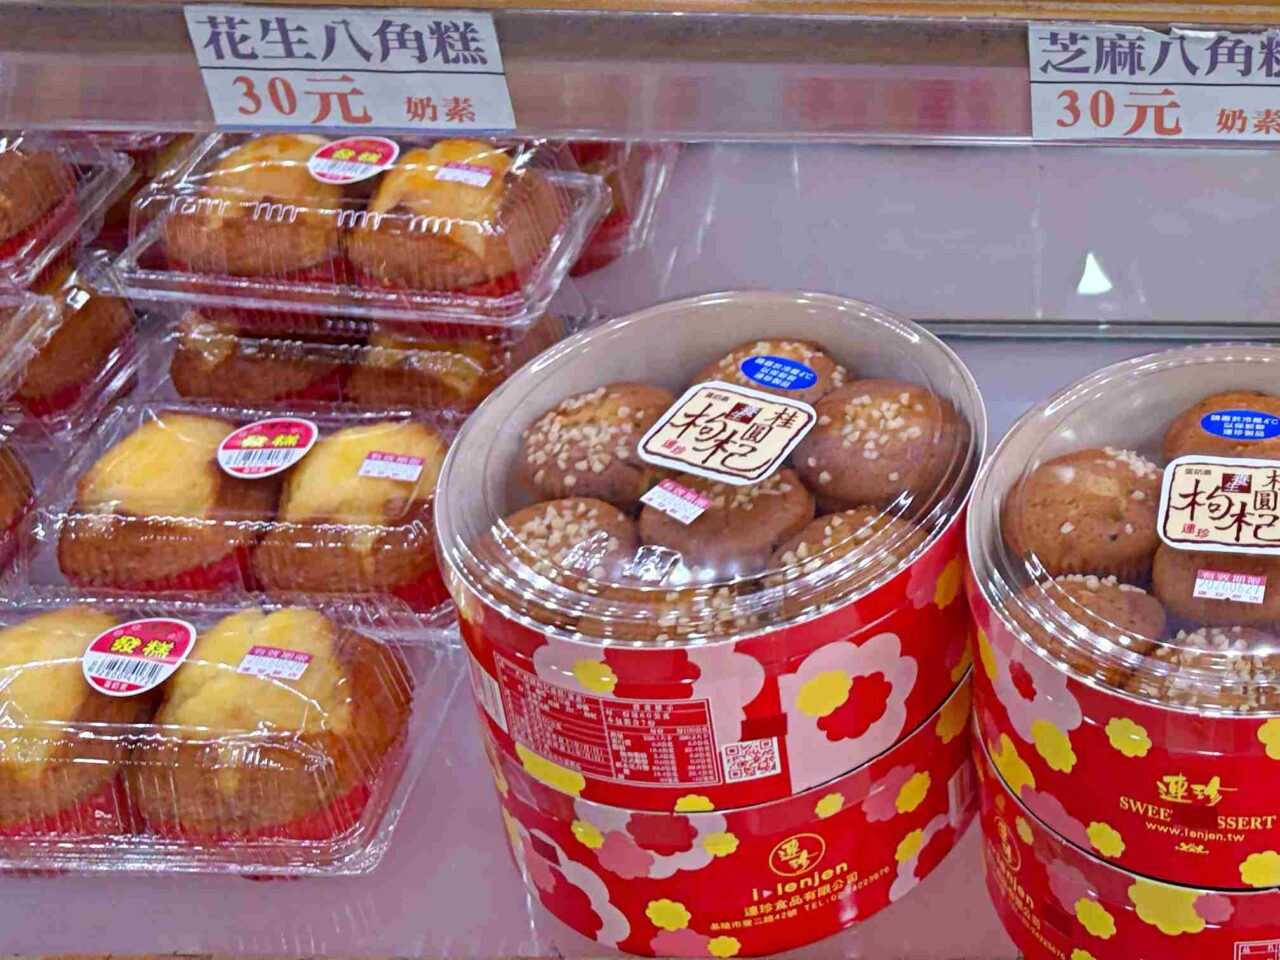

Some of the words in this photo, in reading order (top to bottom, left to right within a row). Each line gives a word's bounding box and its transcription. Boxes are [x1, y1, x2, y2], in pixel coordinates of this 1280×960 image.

[196, 16, 488, 65] 花生八角糕
[233, 75, 373, 125] 30元
[406, 96, 476, 123] 奶素
[1056, 88, 1183, 136] 30元
[670, 403, 772, 471] 枸杞
[1181, 523, 1210, 538] 連珍
[110, 634, 176, 659] 發糕
[1119, 796, 1173, 822] SWEE
[1145, 820, 1245, 842] www.lenjen.tw
